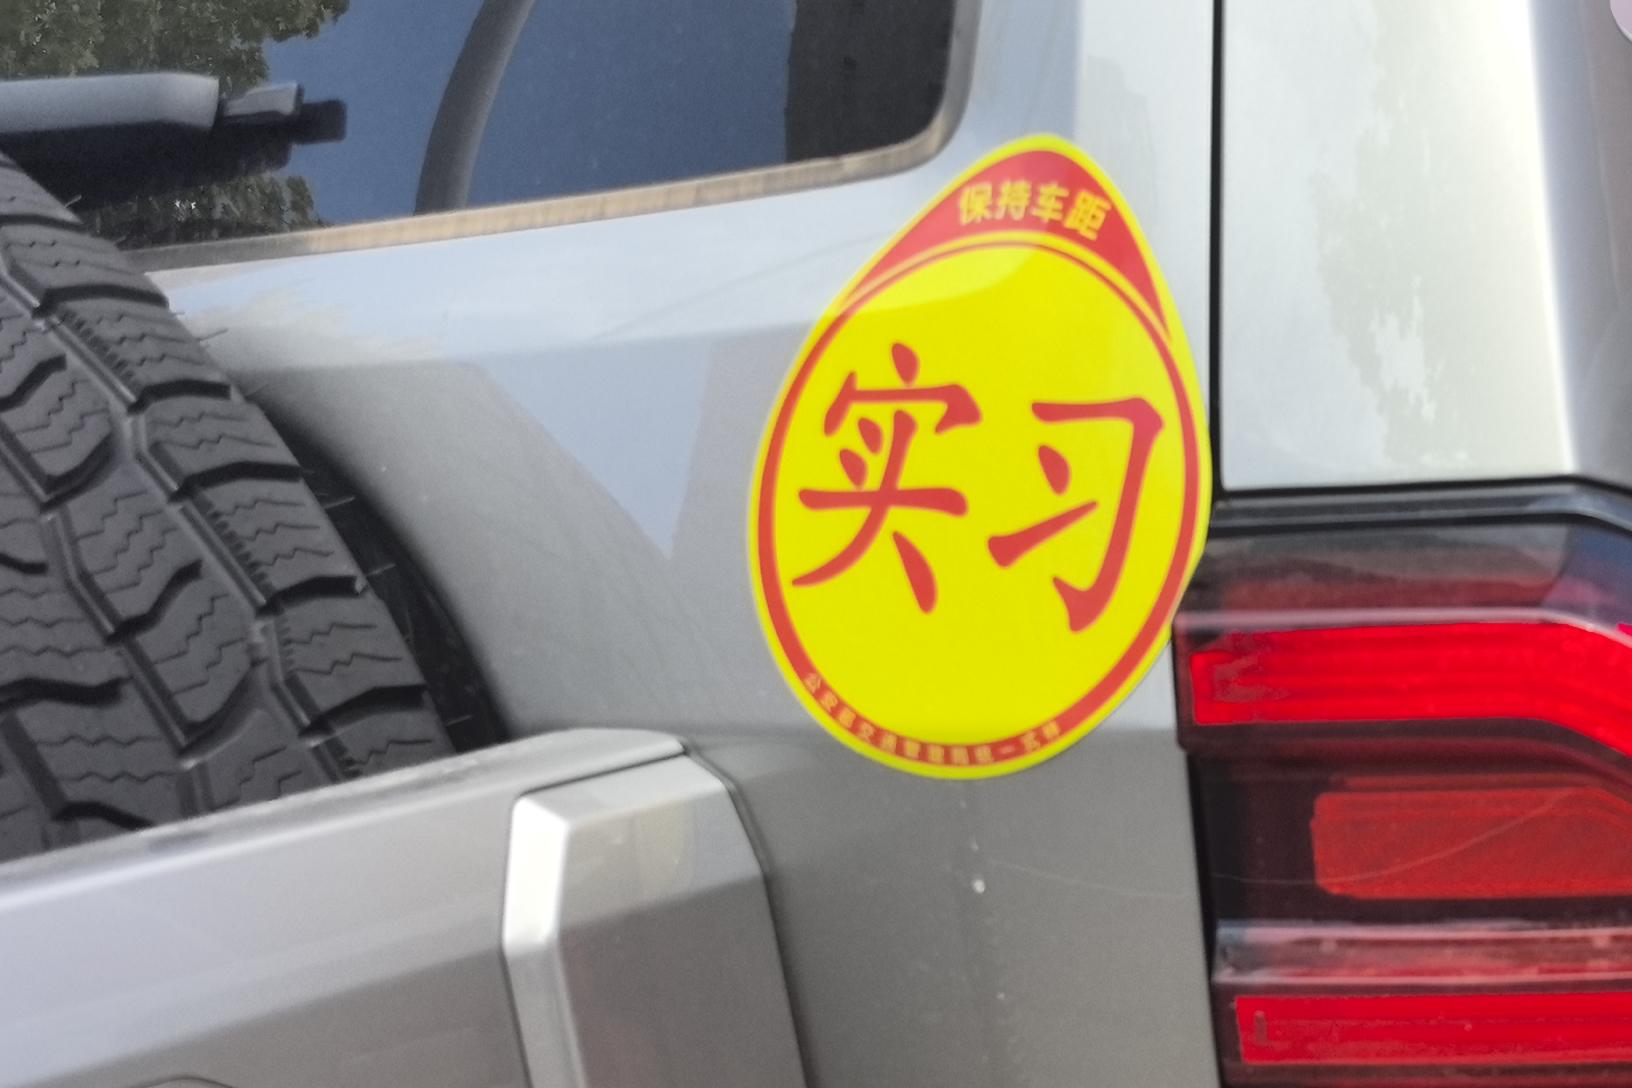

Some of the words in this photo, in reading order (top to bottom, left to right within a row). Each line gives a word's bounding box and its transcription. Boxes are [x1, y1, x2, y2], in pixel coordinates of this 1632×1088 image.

[959, 178, 1112, 241] 保持车距
[791, 341, 1165, 635] 实习
